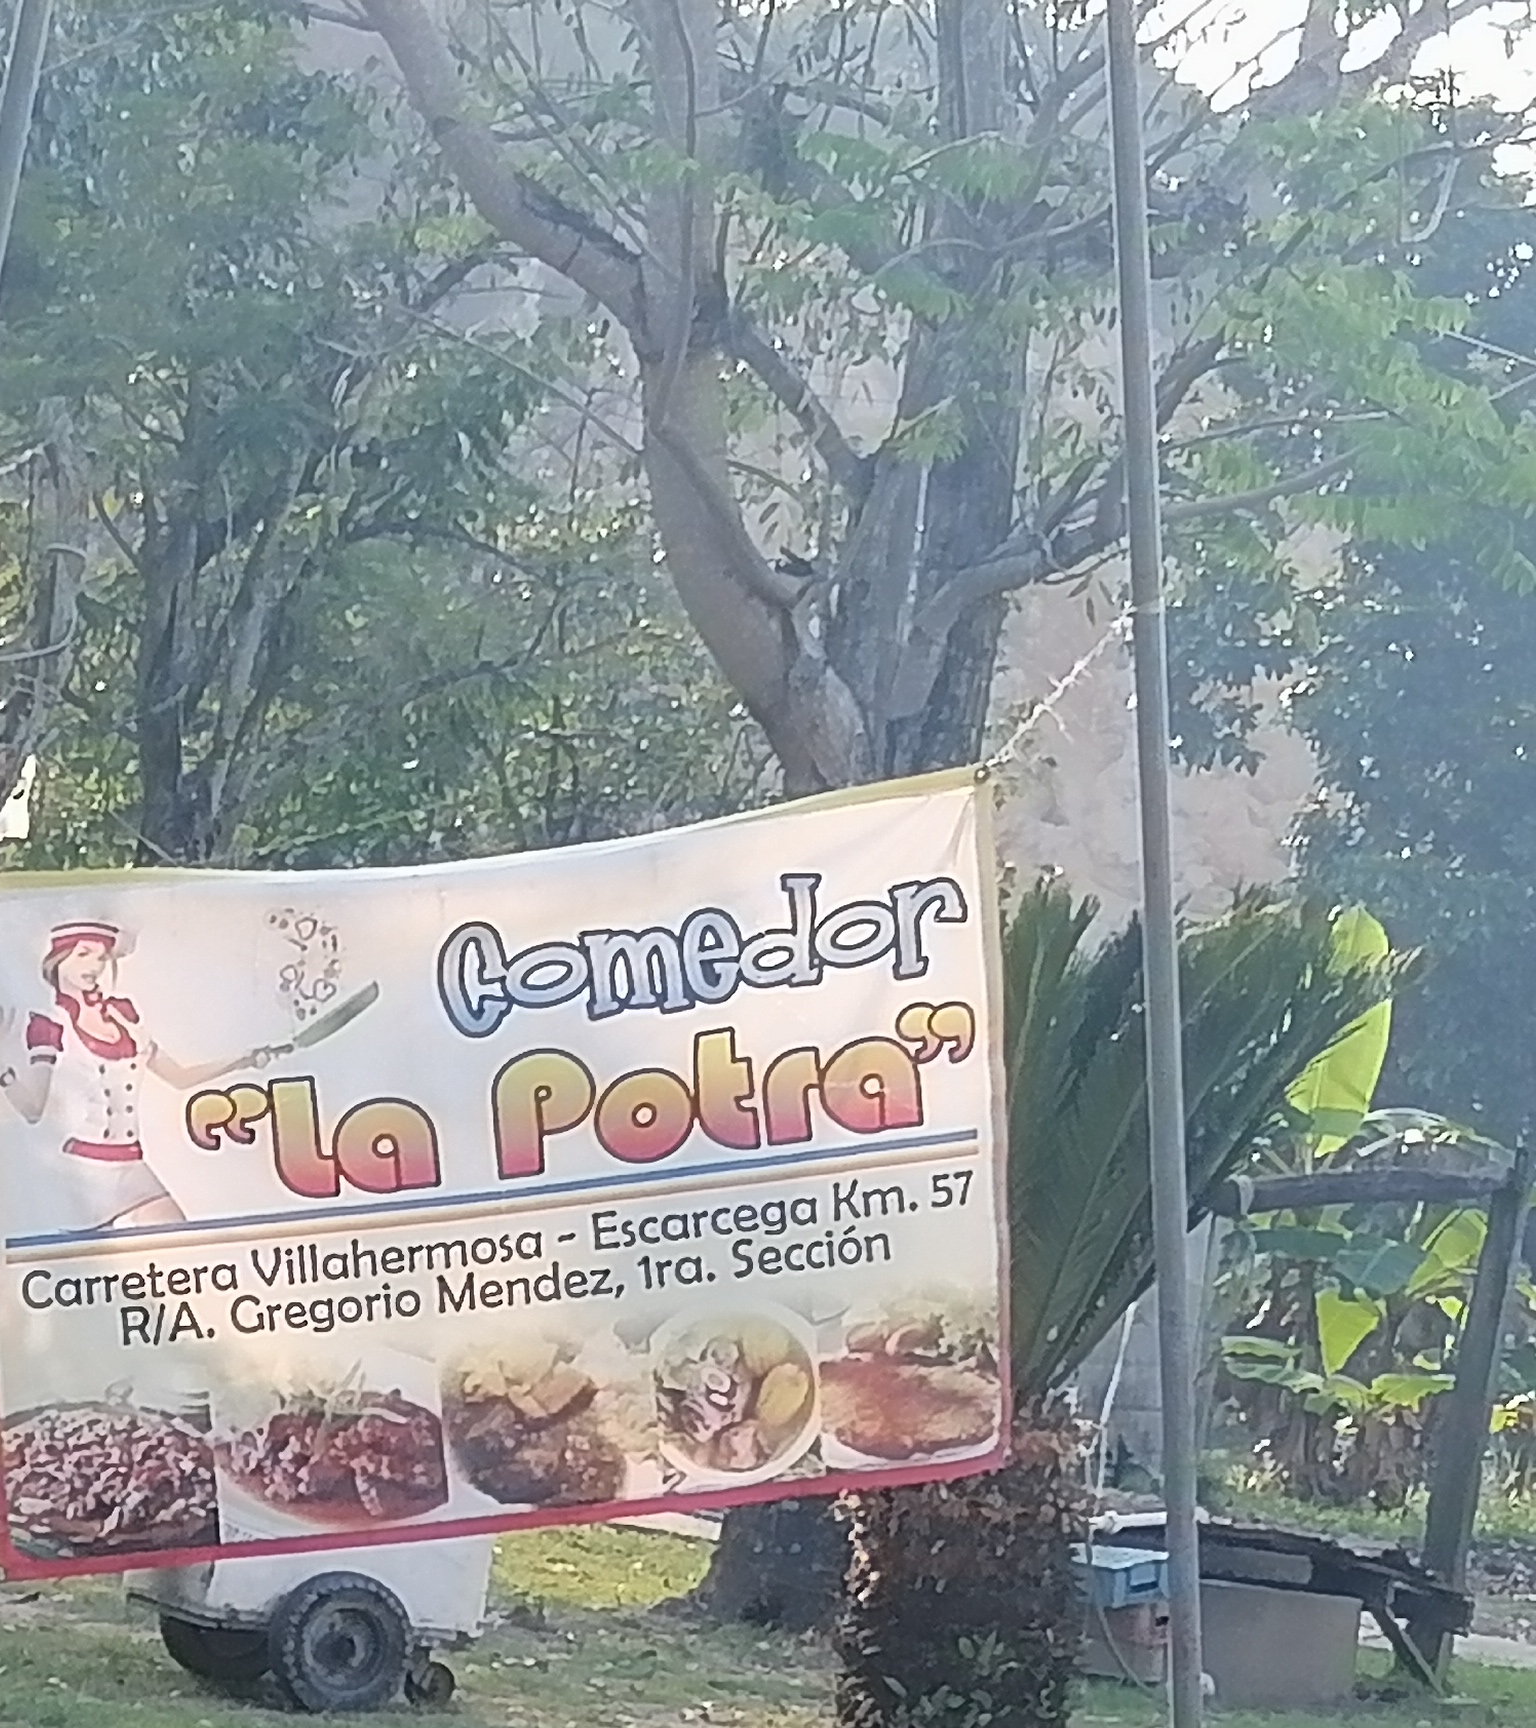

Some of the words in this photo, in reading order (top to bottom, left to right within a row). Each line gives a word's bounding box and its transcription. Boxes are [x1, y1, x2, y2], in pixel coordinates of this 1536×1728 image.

[438, 872, 968, 1038] Comedor
[21, 1264, 238, 1310] Carretera
[250, 1230, 543, 1288] Villahermosa
[592, 1196, 818, 1251] Escarcega
[832, 1179, 918, 1222] Km.
[931, 1170, 974, 1208] 57
[119, 1300, 216, 1346] R/A.
[230, 1283, 421, 1335] Gregorio
[437, 1260, 625, 1316] Mendez,
[637, 1256, 716, 1290] 1ra.
[732, 1225, 892, 1280] Sección
